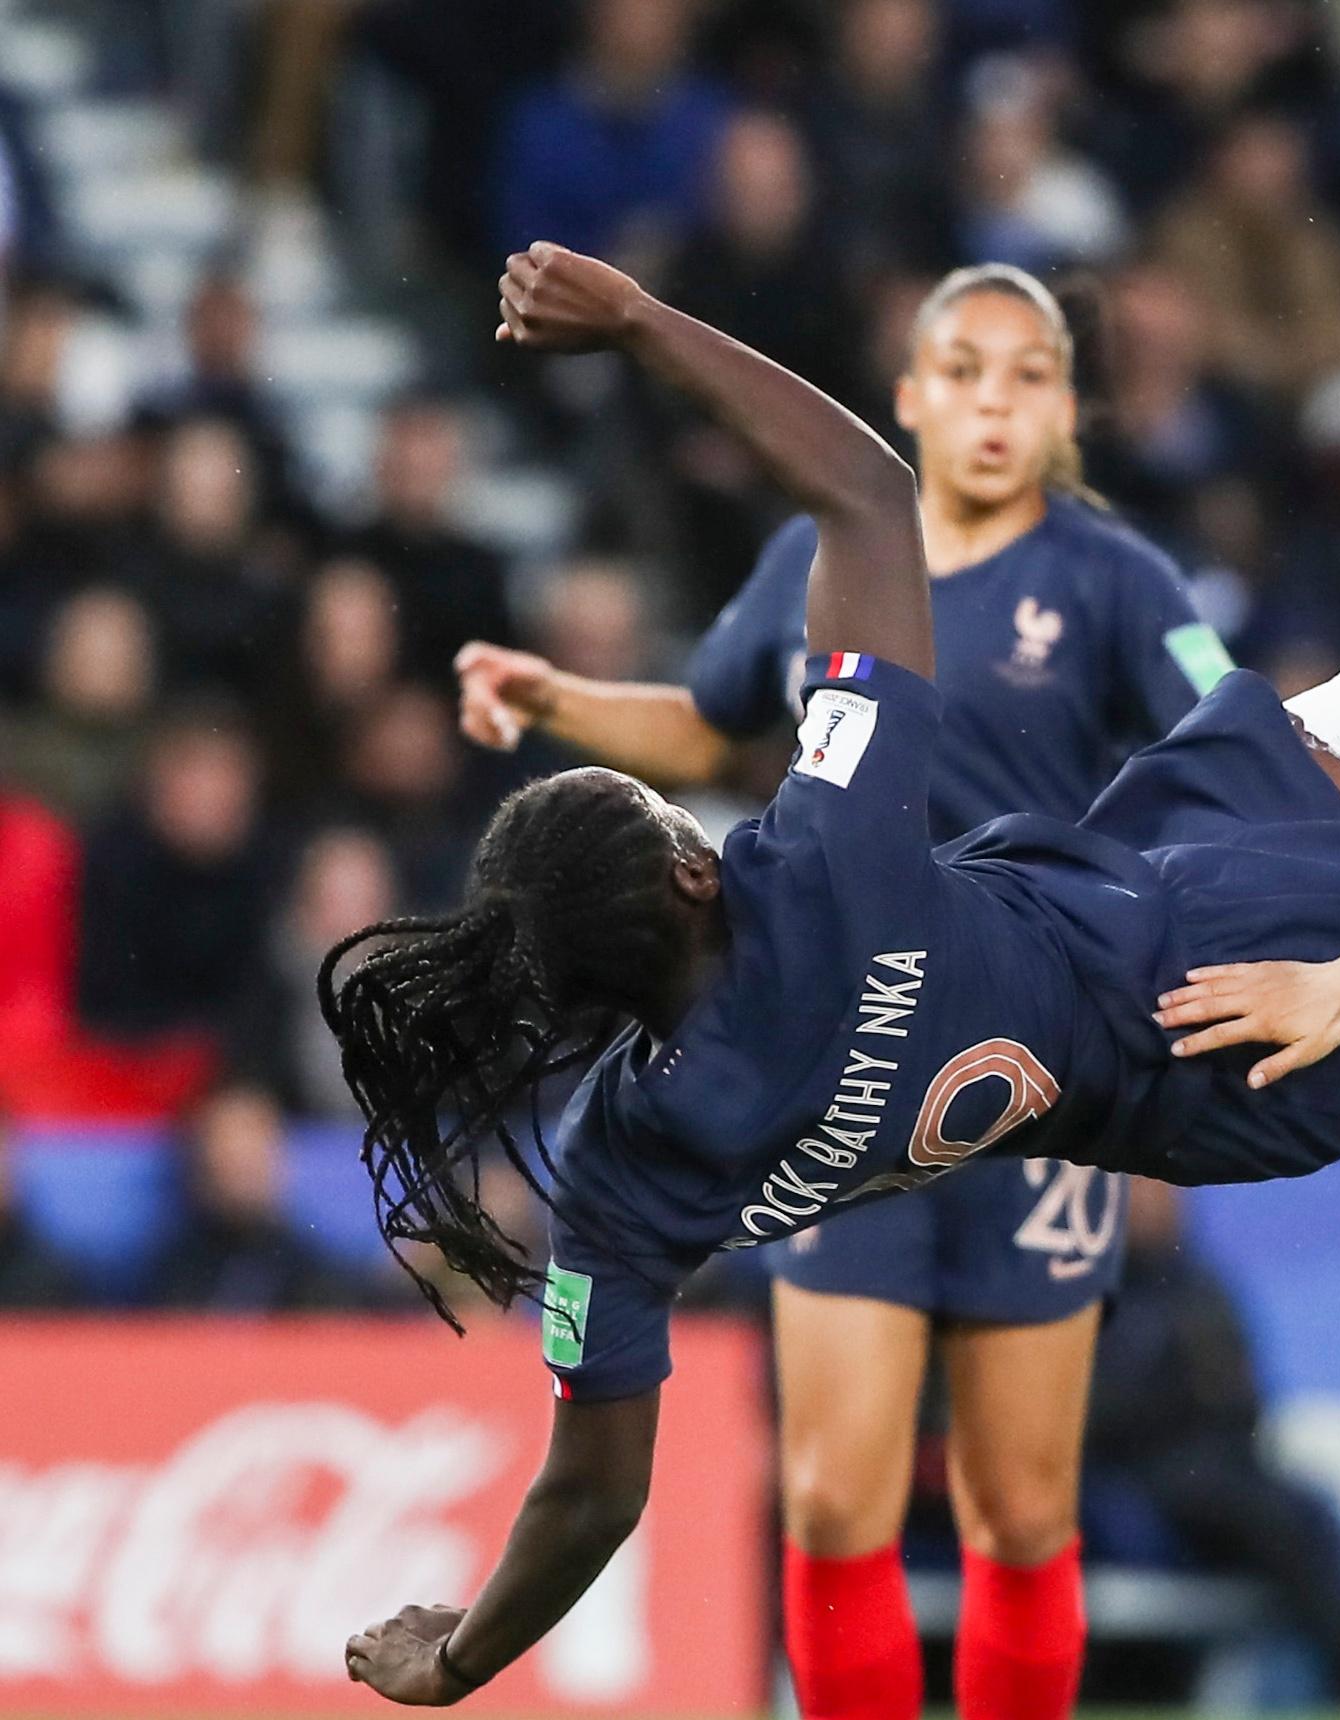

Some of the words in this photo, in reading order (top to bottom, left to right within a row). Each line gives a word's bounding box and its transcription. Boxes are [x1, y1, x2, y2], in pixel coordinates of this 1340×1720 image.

[719, 1159, 839, 1251] OCK
[795, 1048, 899, 1169] BATHY
[855, 950, 928, 1038] NKA
[1012, 1157, 1123, 1258] 20
